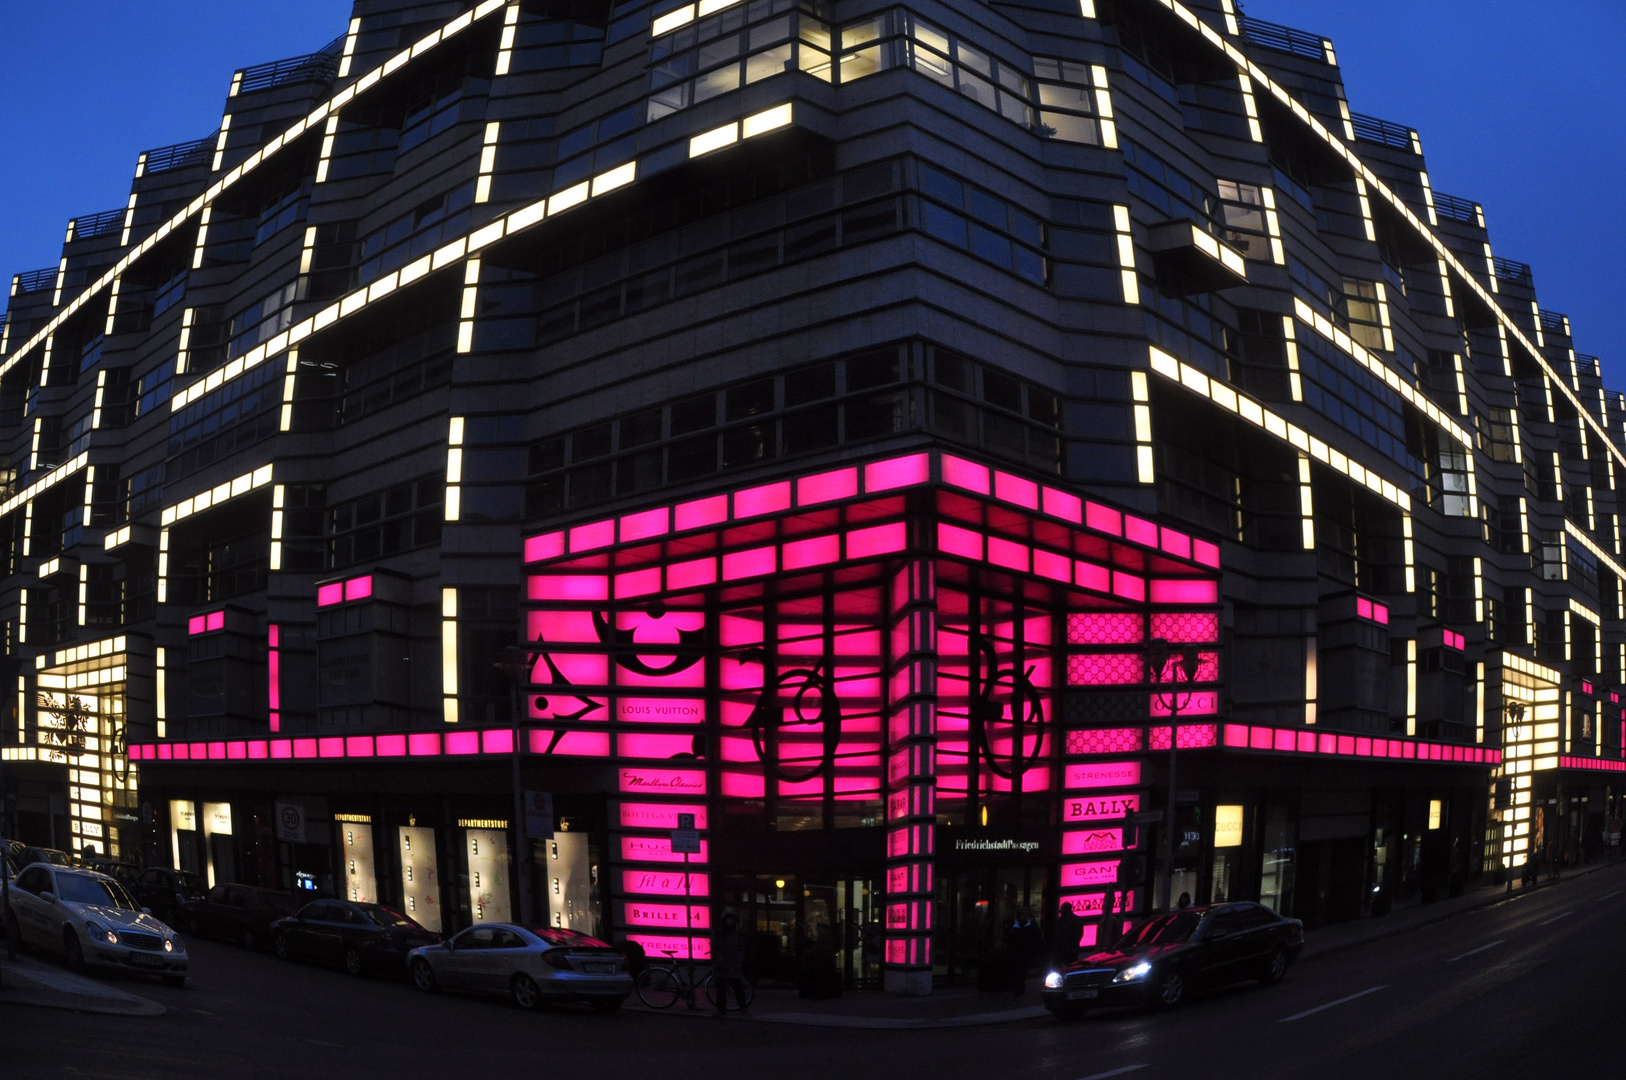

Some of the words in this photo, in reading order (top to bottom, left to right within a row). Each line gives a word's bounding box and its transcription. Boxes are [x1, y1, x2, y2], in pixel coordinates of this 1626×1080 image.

[622, 706, 651, 714] LOUIS
[655, 707, 698, 715] VUITTON
[623, 772, 669, 787] Marlboro
[1074, 770, 1134, 780] STRENESSE
[1071, 799, 1134, 816] BALLY
[285, 812, 297, 825] 30
[622, 810, 664, 819] BOTTEGA
[458, 819, 508, 829] DEPARTMENTSTORE
[635, 874, 656, 889] fil
[661, 877, 670, 888] à
[640, 942, 704, 951] TRENESSE
